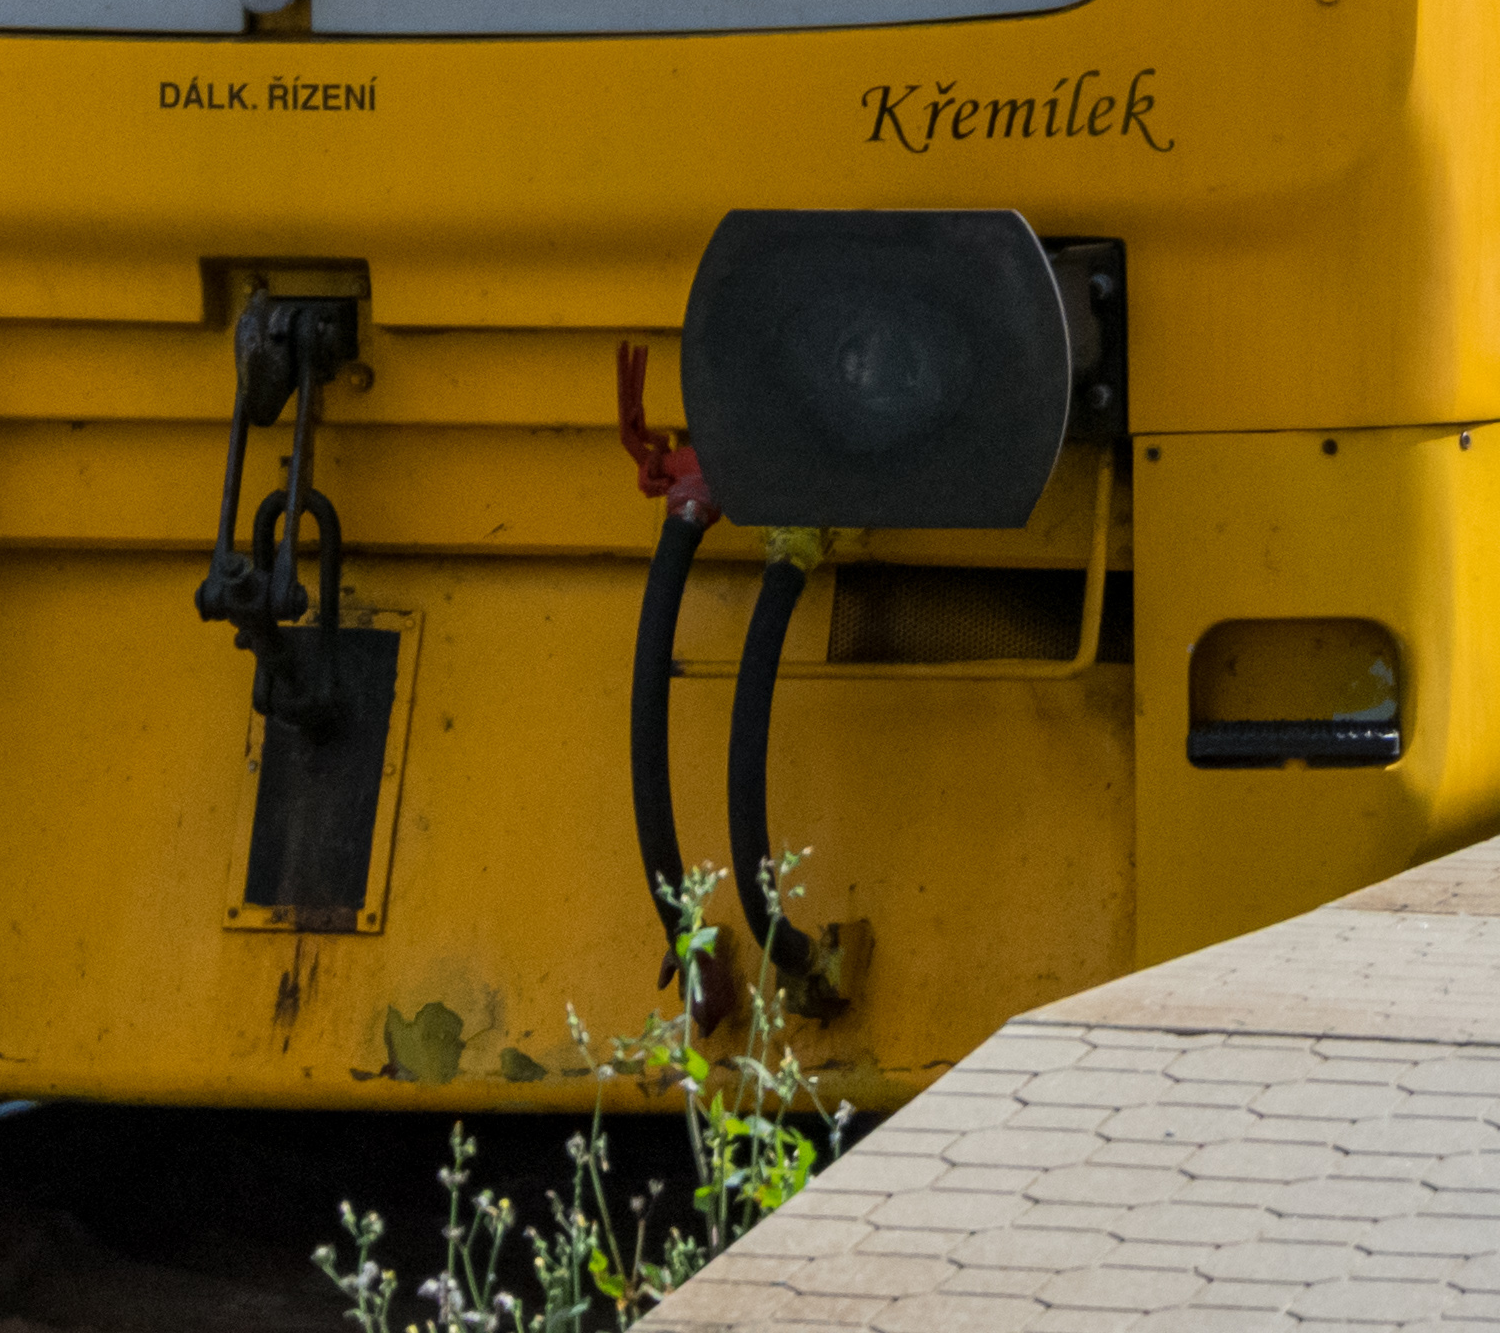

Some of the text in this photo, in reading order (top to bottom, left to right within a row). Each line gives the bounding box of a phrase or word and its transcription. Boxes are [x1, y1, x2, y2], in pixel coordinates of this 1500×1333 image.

[159, 75, 378, 112] DÁLK. ŘÍZENÍ
[861, 68, 1176, 154] Křemílek
